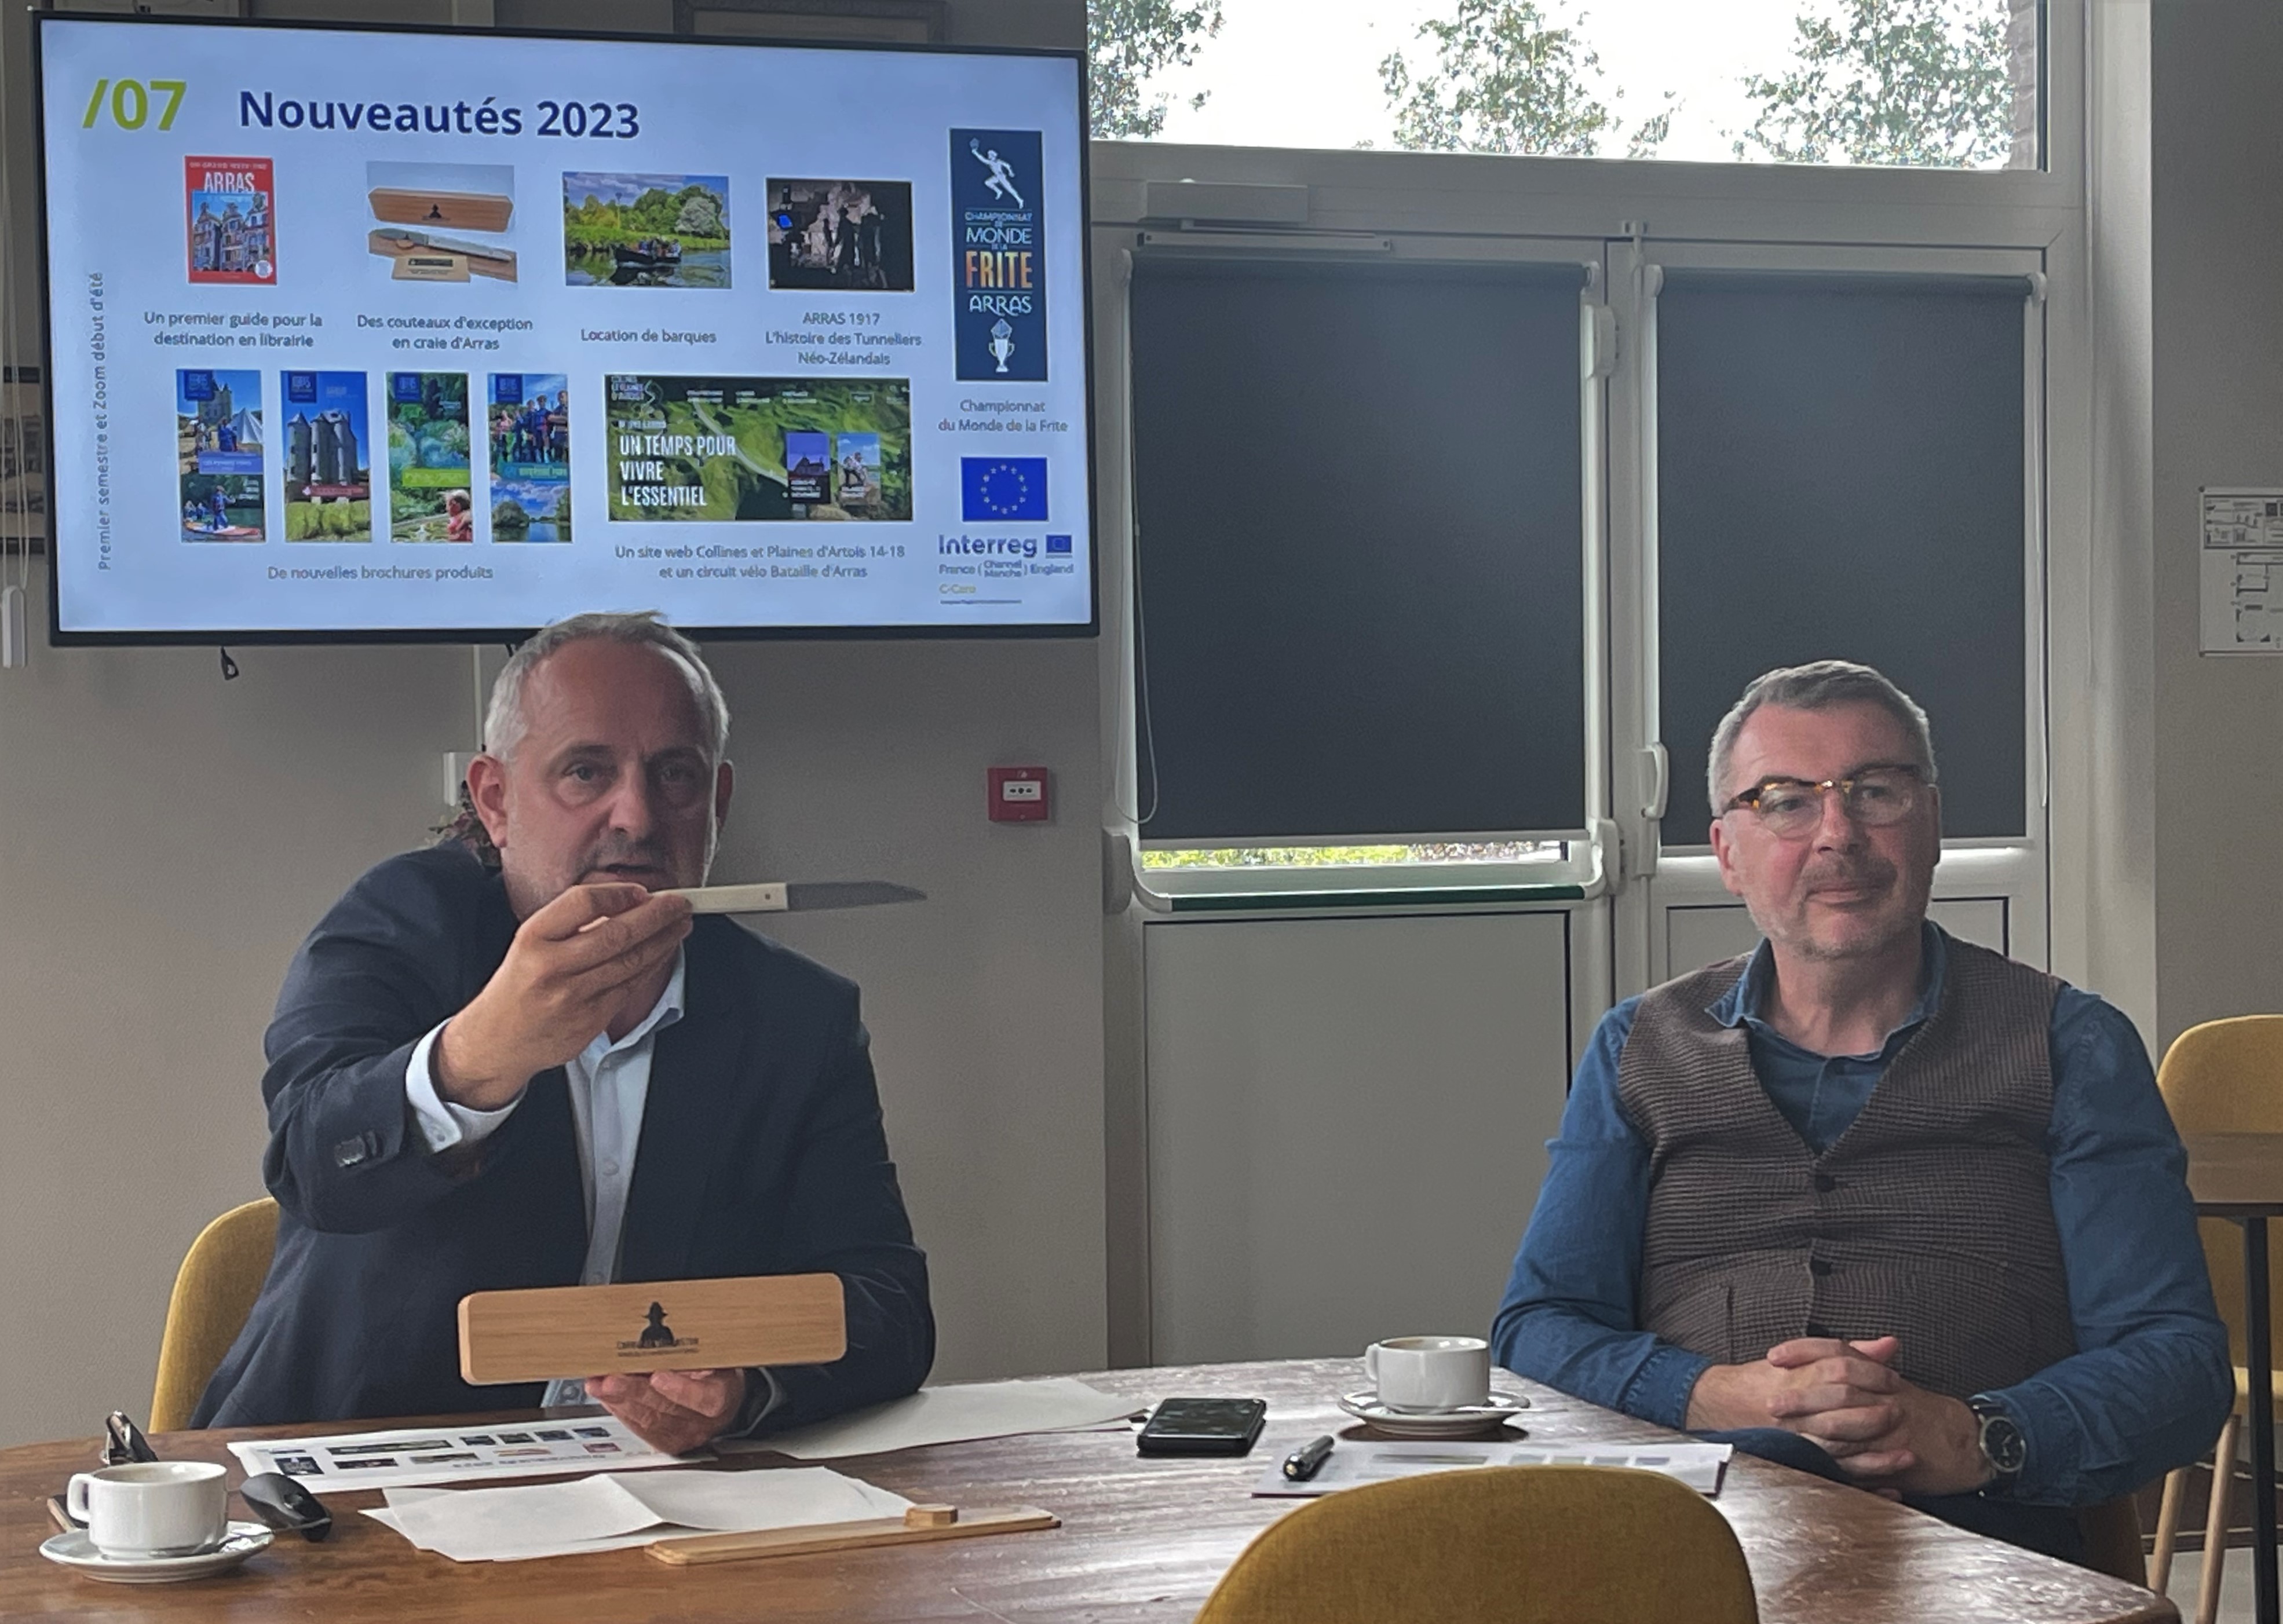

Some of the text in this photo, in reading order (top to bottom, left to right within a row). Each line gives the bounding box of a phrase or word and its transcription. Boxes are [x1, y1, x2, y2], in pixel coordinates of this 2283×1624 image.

[82, 78, 187, 131] /07
[239, 90, 640, 139] Nouveautés 2023
[204, 171, 255, 193] ARRAS
[966, 228, 1032, 244] MONDE
[966, 251, 1032, 288] FRITE
[969, 295, 1032, 316] ARRAS
[144, 312, 323, 328] Un premier guide pour la
[357, 314, 533, 332] Des couteaux d'exception
[802, 313, 880, 325] ARRAS 1917
[154, 331, 314, 347] destination en librairie
[392, 336, 499, 350] en craie d'Arras
[580, 328, 717, 345] Location de barques
[765, 331, 824, 345] L'histoire
[828, 332, 851, 345] des
[797, 352, 891, 365] Néo-Zélandais
[959, 399, 1045, 415] Championnat
[89, 272, 111, 571] Premier semestre et Zoom début d'été
[938, 419, 1068, 431] du Monde de la Frite
[620, 435, 736, 456] UN TEMPS POUR
[620, 461, 664, 481] VIVRE
[621, 486, 708, 506] L'ESSENTIEL
[615, 545, 905, 558] Un site web Collines et Plaines d'Artois 14-18
[938, 534, 1038, 558] Interreg
[268, 565, 494, 581] De nouvelles brochures produits
[659, 564, 868, 578] et un circuit vélo Bataille d'Arras
